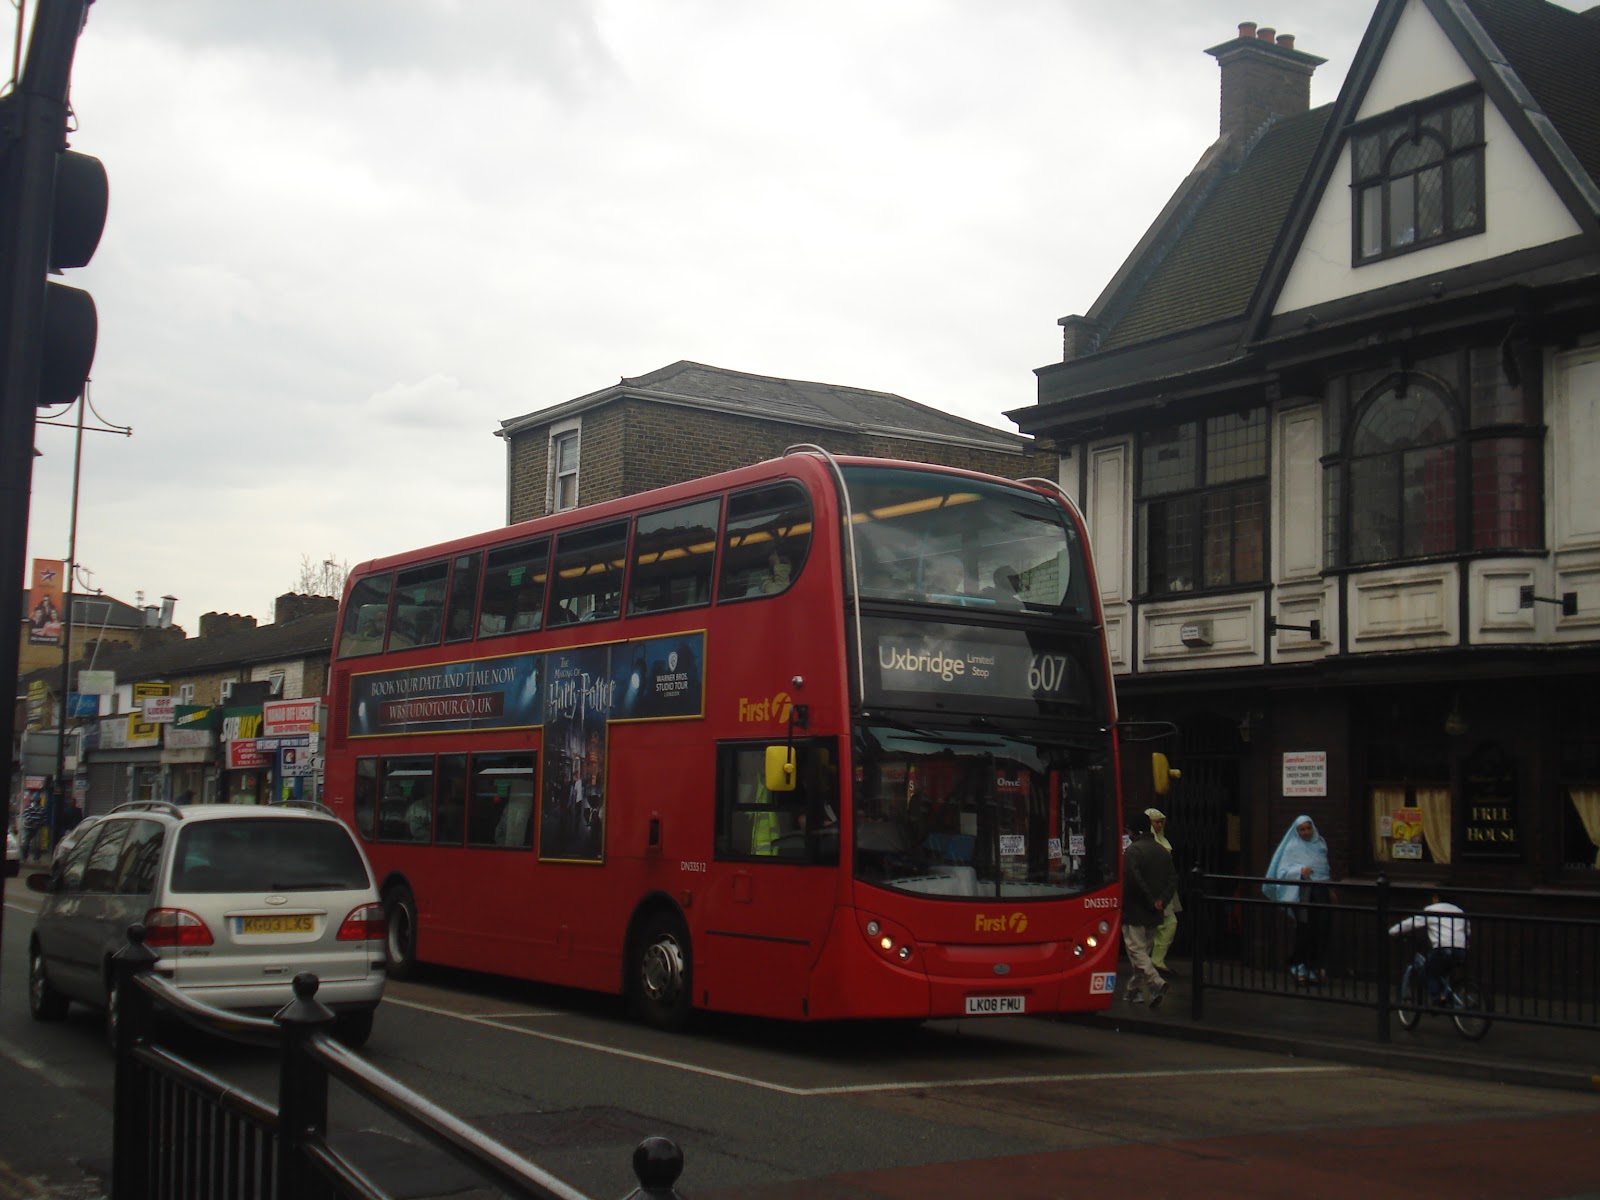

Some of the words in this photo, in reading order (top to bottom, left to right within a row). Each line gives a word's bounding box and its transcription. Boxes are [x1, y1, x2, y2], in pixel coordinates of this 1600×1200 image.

[879, 645, 966, 682] Uxbridge
[966, 653, 994, 666] Limited
[656, 674, 675, 683] WARNER
[971, 666, 990, 680] Stop
[1027, 653, 1068, 692] 607
[371, 681, 395, 696] BOOK
[395, 677, 419, 693] YOUR
[419, 674, 442, 691] DATE
[442, 672, 464, 688] AND
[465, 669, 489, 687] TIME
[491, 666, 517, 684] NOW
[655, 682, 675, 692] STUDIO
[675, 680, 689, 690] TOUR
[548, 680, 578, 722] Harry
[579, 672, 616, 721] Potter
[738, 697, 770, 722] First
[220, 714, 262, 743] SUBWAY
[1471, 807, 1512, 822] FREE
[1466, 827, 1519, 842] HOUSE
[680, 861, 707, 872] DN33512
[1083, 898, 1118, 909] DN33512
[975, 914, 1007, 931] First
[970, 999, 997, 1012] LK08
[999, 998, 1021, 1011] FMU
